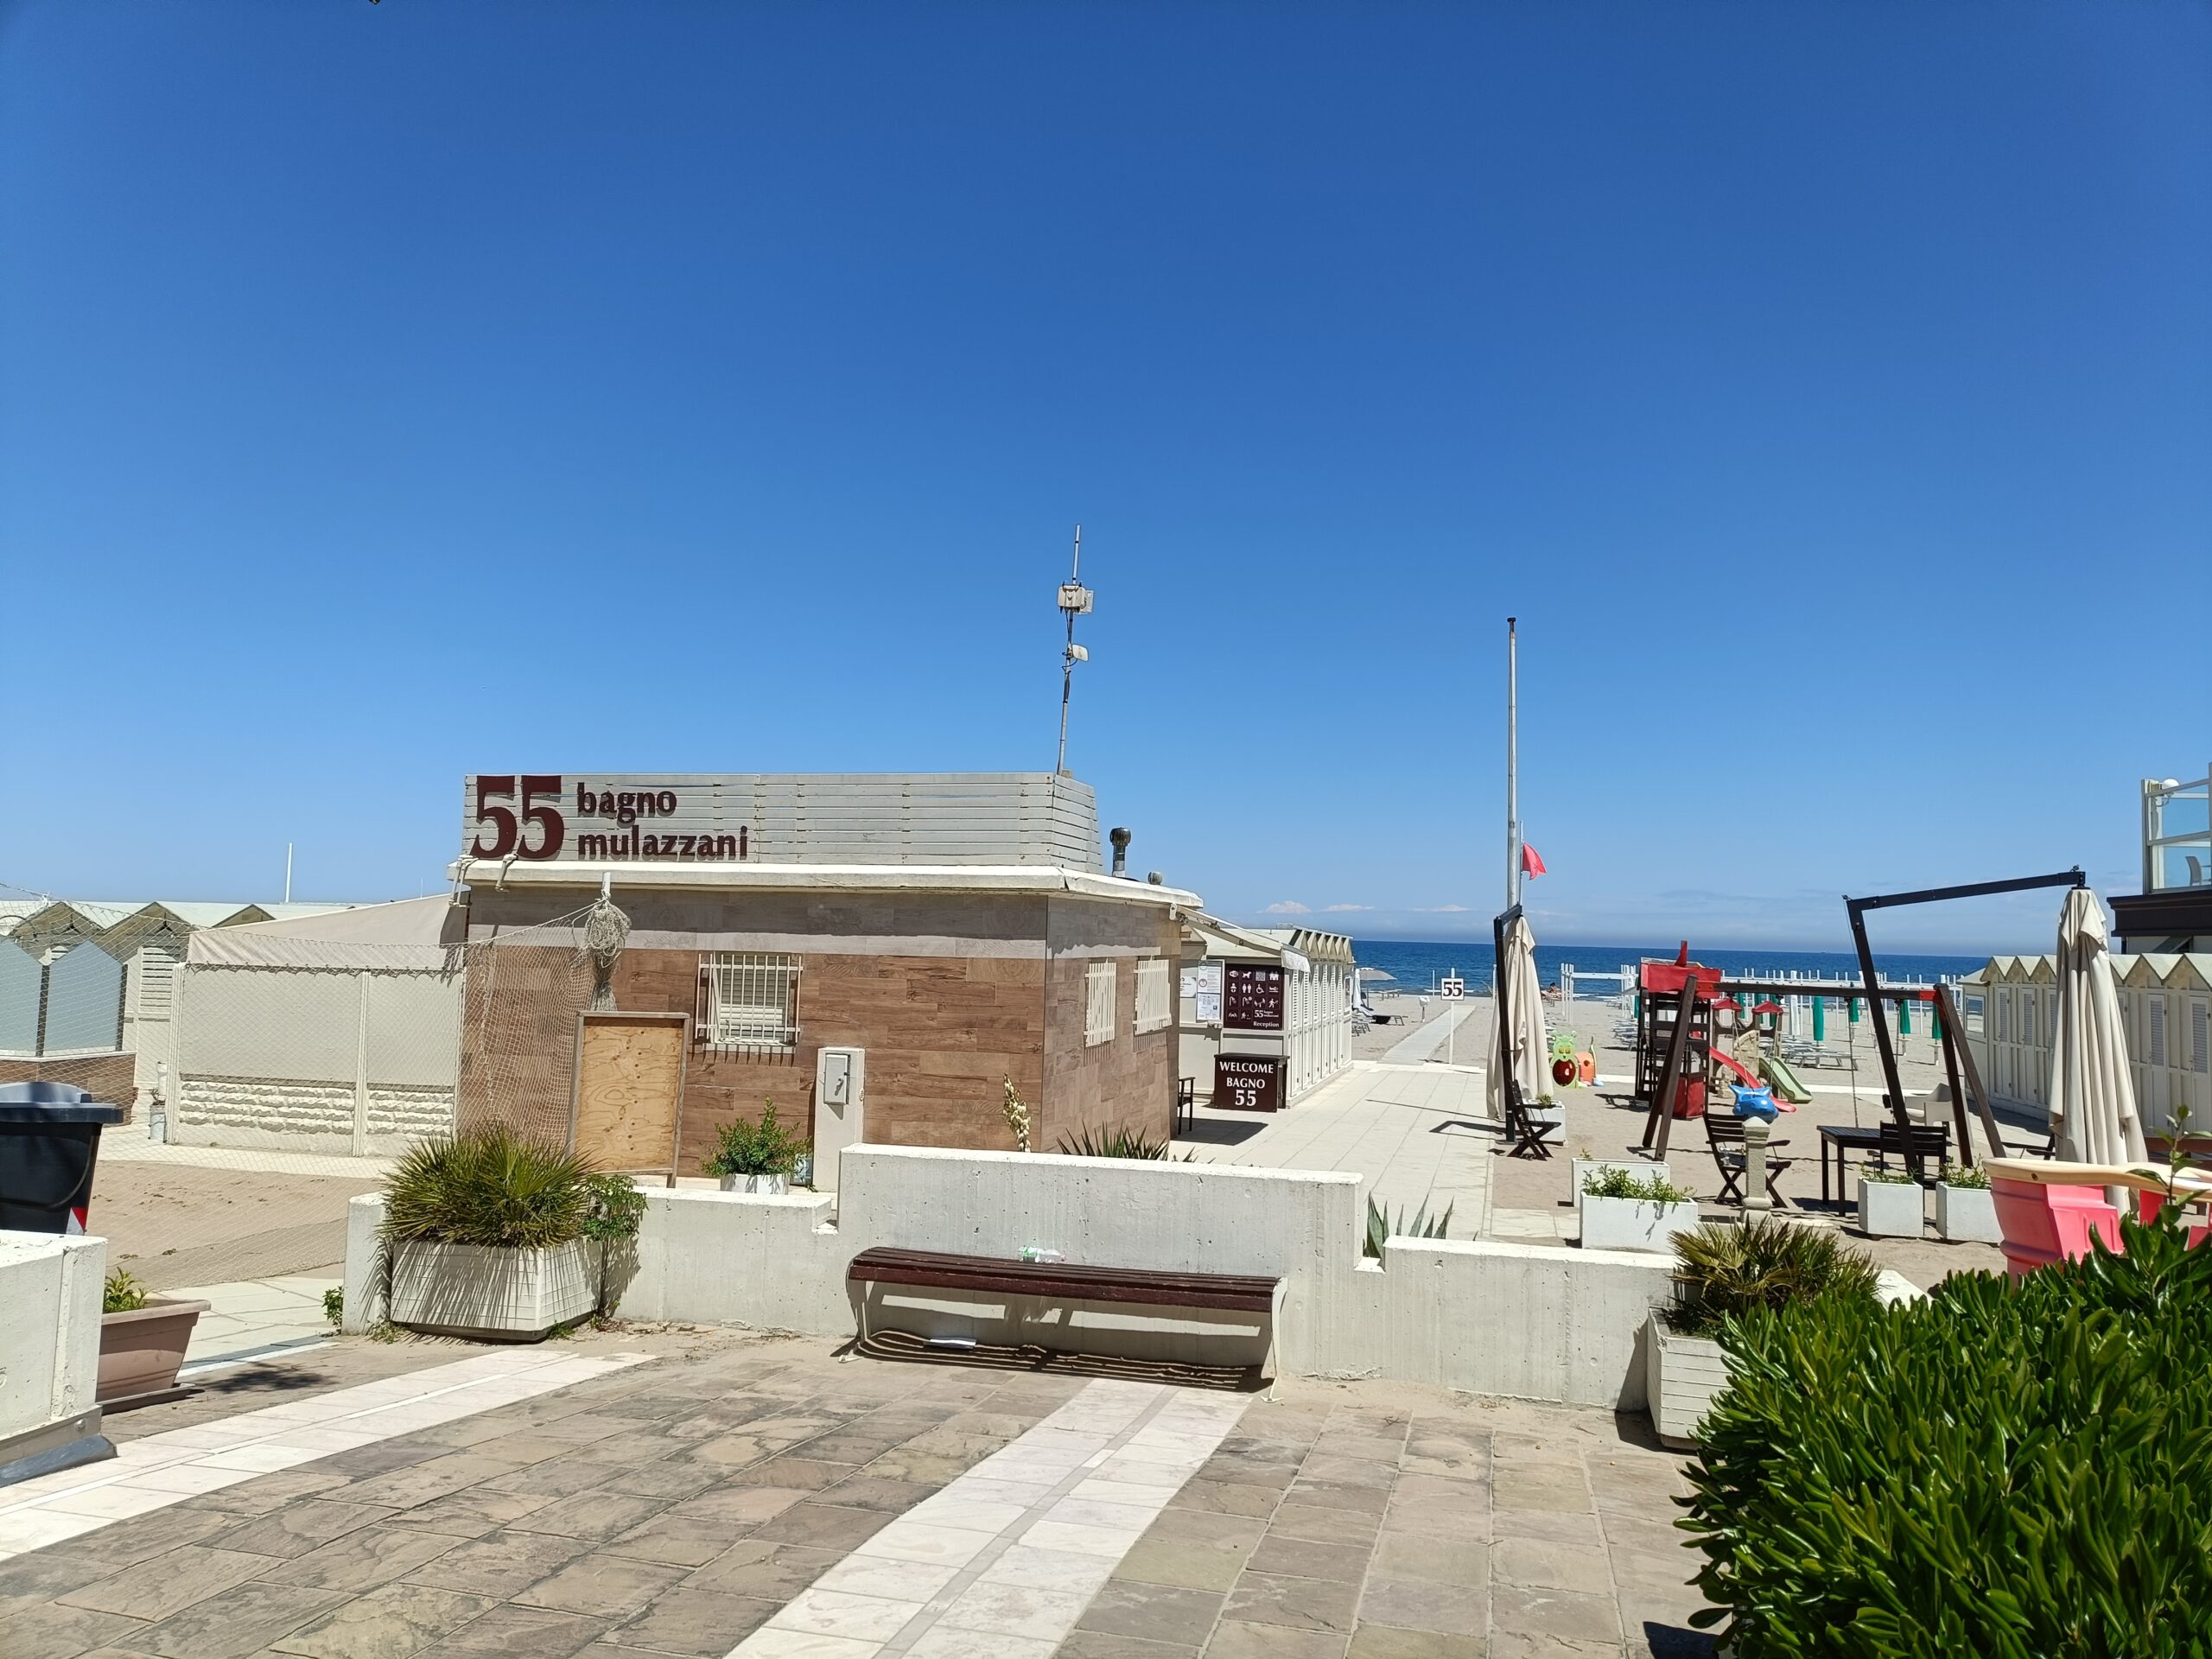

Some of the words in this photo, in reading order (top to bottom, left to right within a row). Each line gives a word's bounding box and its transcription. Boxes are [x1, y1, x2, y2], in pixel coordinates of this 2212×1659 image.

[577, 782, 677, 824] bagno
[470, 775, 563, 859] 55
[578, 825, 748, 857] mulazzani
[1443, 982, 1462, 996] 55
[1255, 1009, 1264, 1018] 55
[1219, 1061, 1274, 1073] WELCOME
[1226, 1077, 1265, 1089] BAGNO
[1235, 1090, 1256, 1106] 55
